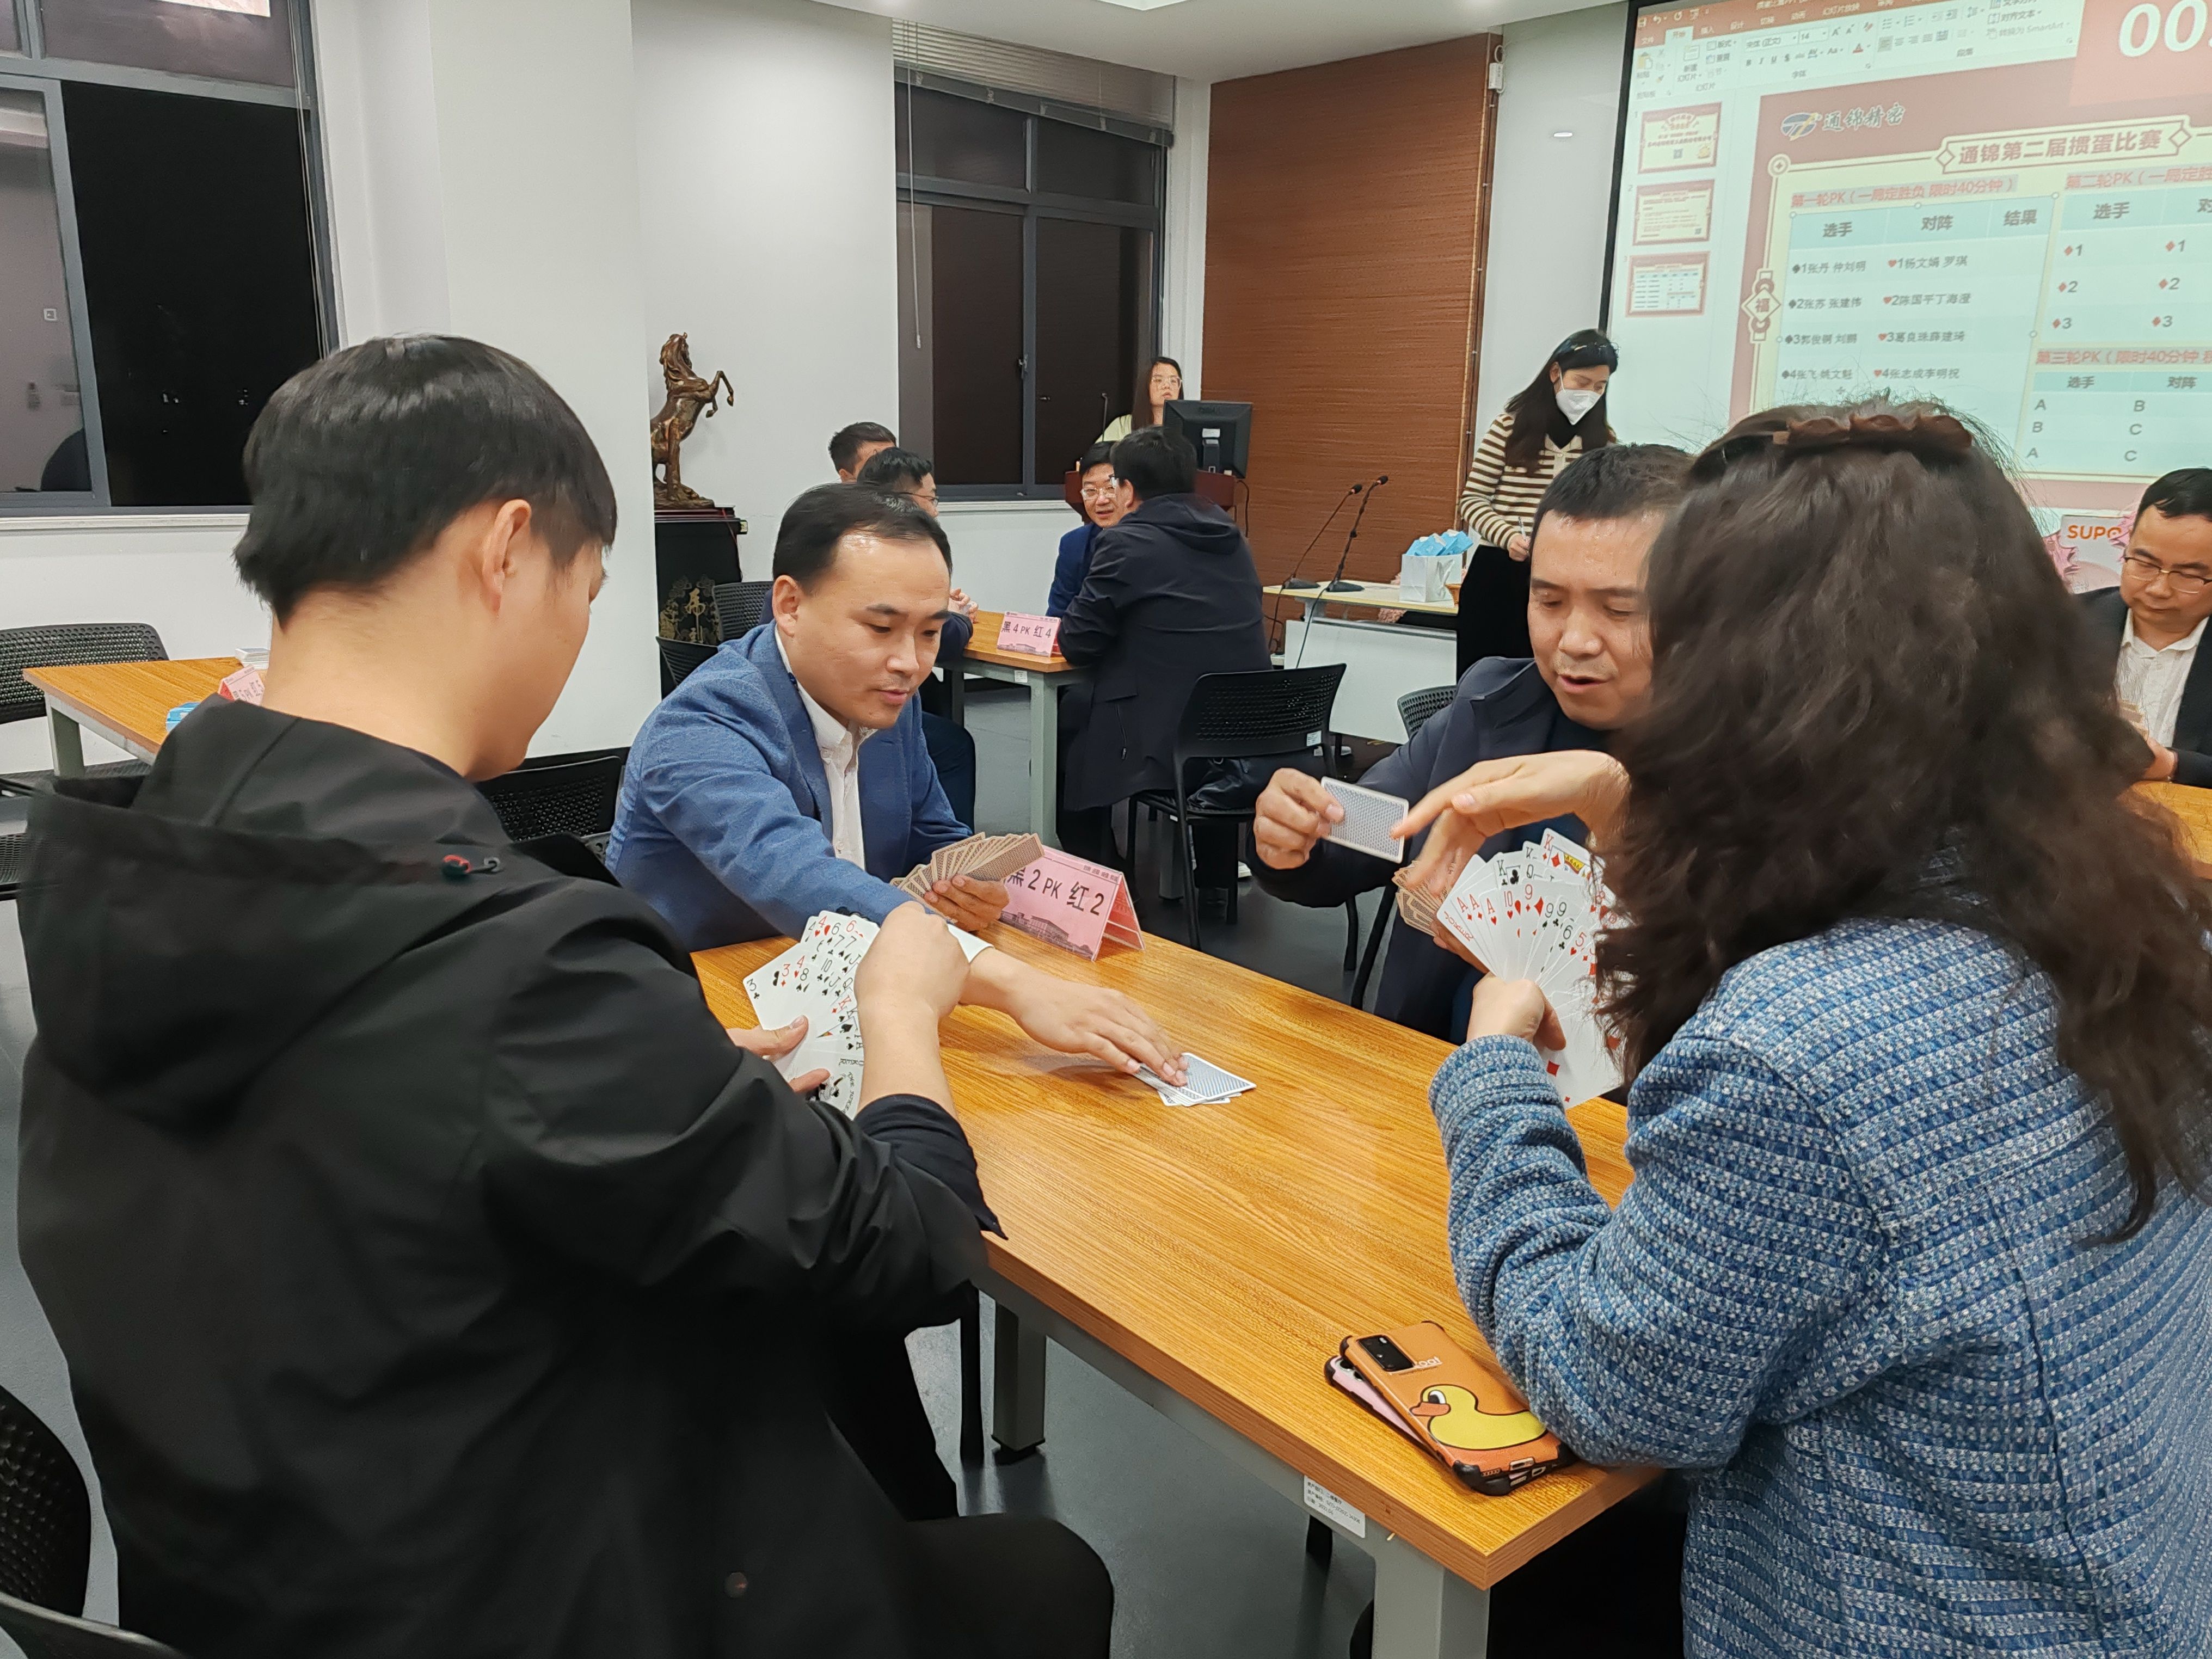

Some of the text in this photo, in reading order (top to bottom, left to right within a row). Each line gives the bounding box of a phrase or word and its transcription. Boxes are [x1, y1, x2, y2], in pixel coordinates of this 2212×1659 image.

[1822, 102, 1905, 131] 通锦精密
[1958, 129, 2162, 164] 通锦第二届掼蛋比赛
[2093, 201, 2130, 219] 选手
[1823, 210, 2037, 238] 选手 对阵 结果
[2075, 244, 2084, 256] 1
[2178, 239, 2186, 252] 1
[2068, 281, 2078, 293] 2
[2169, 278, 2180, 290] 2
[1755, 298, 1770, 313] 福
[2062, 318, 2073, 329] 3
[2162, 316, 2173, 327] 3
[2067, 376, 2197, 389] 选手 对阵
[2035, 399, 2145, 412] A B
[2032, 422, 2142, 435] B C
[2026, 447, 2137, 462] A C
[1020, 626, 1031, 635] PK
[1544, 833, 1554, 851] K
[1497, 859, 1507, 876] K
[1526, 864, 1534, 878] Q
[1042, 877, 1062, 899] PK
[1525, 884, 1533, 900] 9
[1457, 896, 1468, 913] A
[1470, 894, 1479, 910] A
[1504, 890, 1513, 907] 10
[1486, 898, 1495, 914] A
[1545, 902, 1554, 918] 9
[1557, 902, 1567, 917] 9
[818, 915, 827, 928] 4
[831, 922, 841, 935] 6
[846, 920, 857, 932] 6
[1444, 911, 1474, 942] JOKER
[1563, 925, 1574, 940] 6
[1575, 931, 1587, 947] 5
[834, 934, 845, 947] 7
[845, 936, 857, 948] 7
[796, 955, 805, 968] 4
[821, 958, 832, 973] 10
[849, 953, 862, 965] J
[782, 963, 791, 977] 3
[800, 968, 809, 981] 8
[747, 978, 757, 992] 3
[829, 976, 841, 987] J
[843, 977, 853, 991] Q
[838, 995, 851, 1010] K
[839, 1058, 864, 1067] OKER
